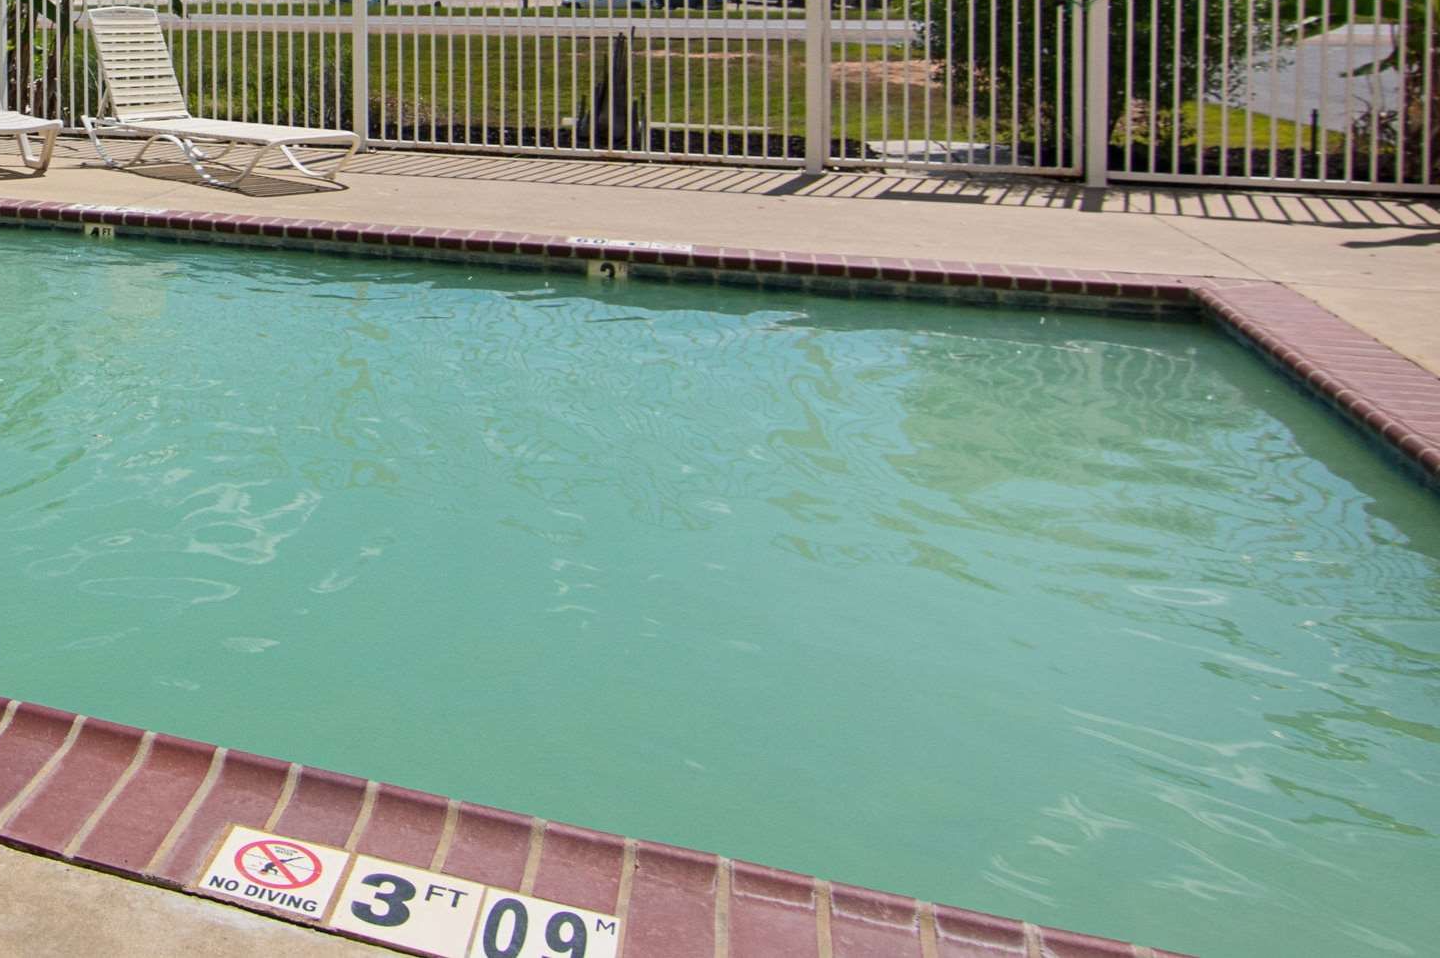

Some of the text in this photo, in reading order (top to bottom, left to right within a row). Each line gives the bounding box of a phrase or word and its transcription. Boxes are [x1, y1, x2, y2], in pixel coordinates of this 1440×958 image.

[208, 875, 318, 913] NO DIVING
[351, 873, 416, 928] 3
[424, 883, 469, 908] FT
[595, 918, 616, 936] M
